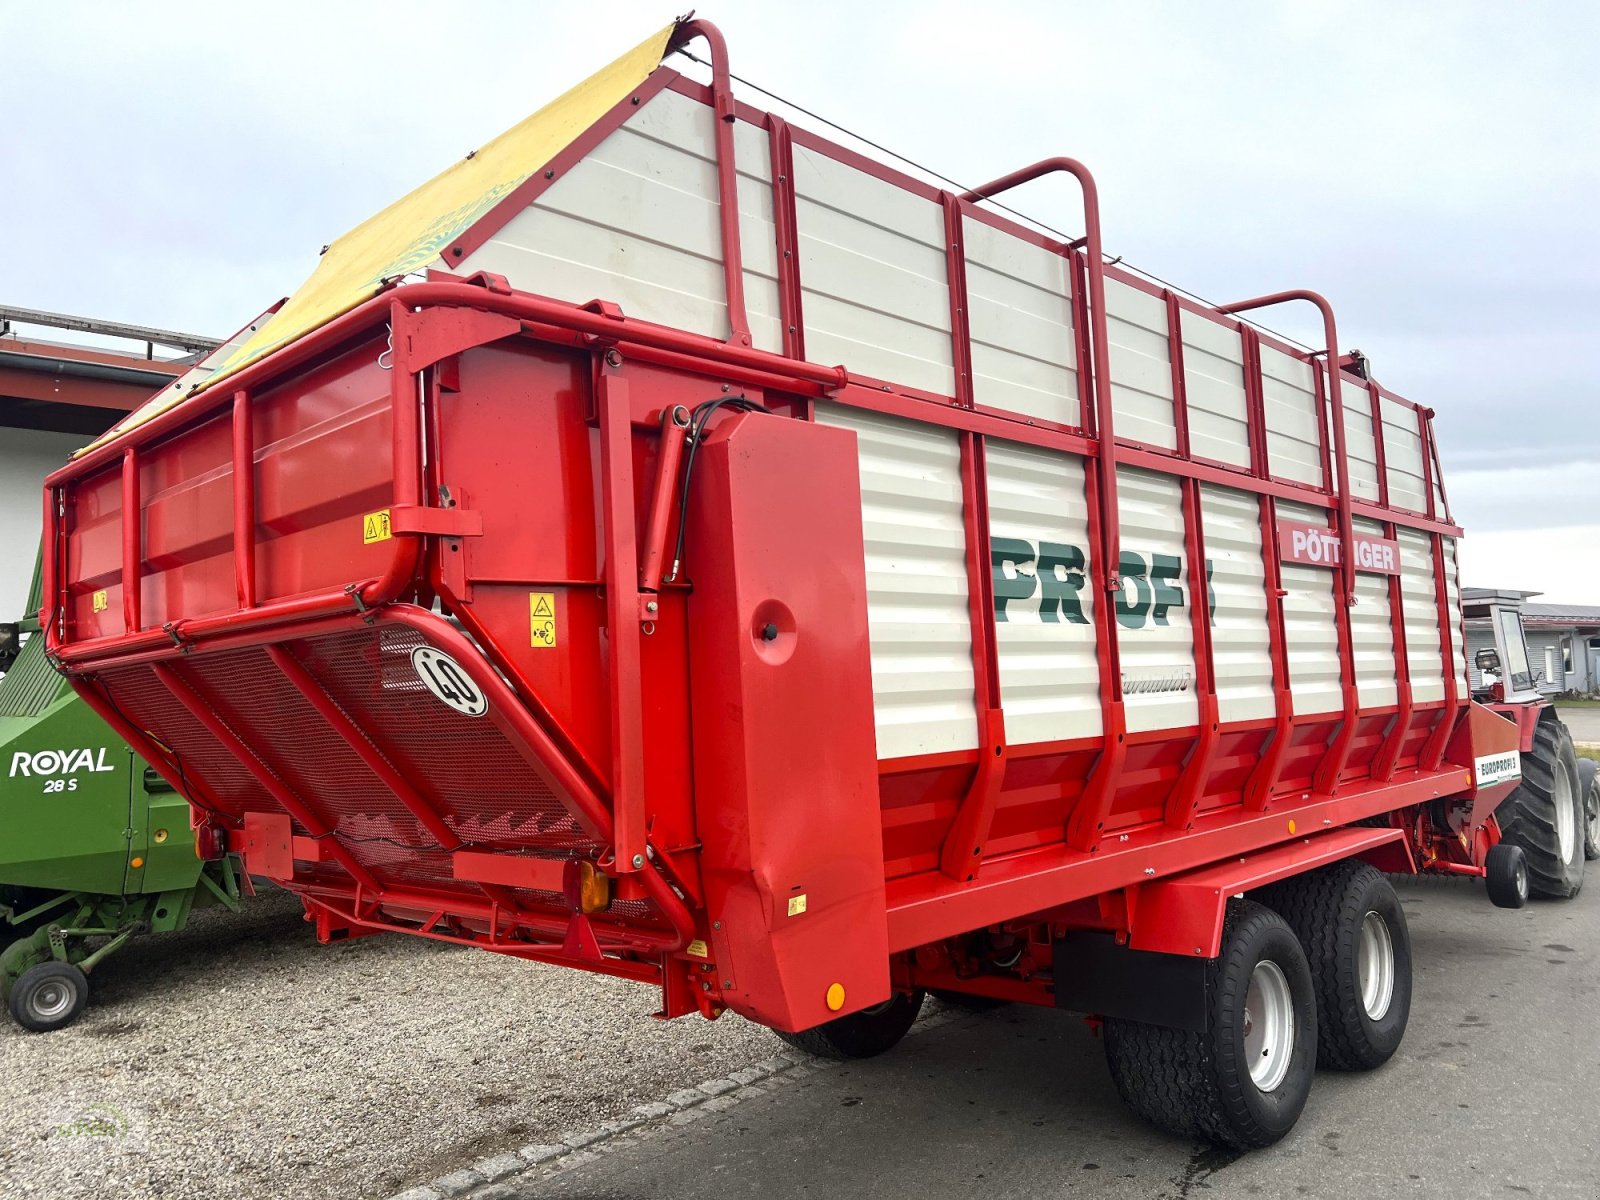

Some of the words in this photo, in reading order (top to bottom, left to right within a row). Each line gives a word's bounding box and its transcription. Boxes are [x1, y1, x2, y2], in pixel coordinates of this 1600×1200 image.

[1292, 528, 1395, 570] PÖTTGER
[421, 659, 478, 704] 40
[9, 747, 115, 777] ROYAL
[43, 779, 65, 794] 28
[67, 778, 78, 791] S
